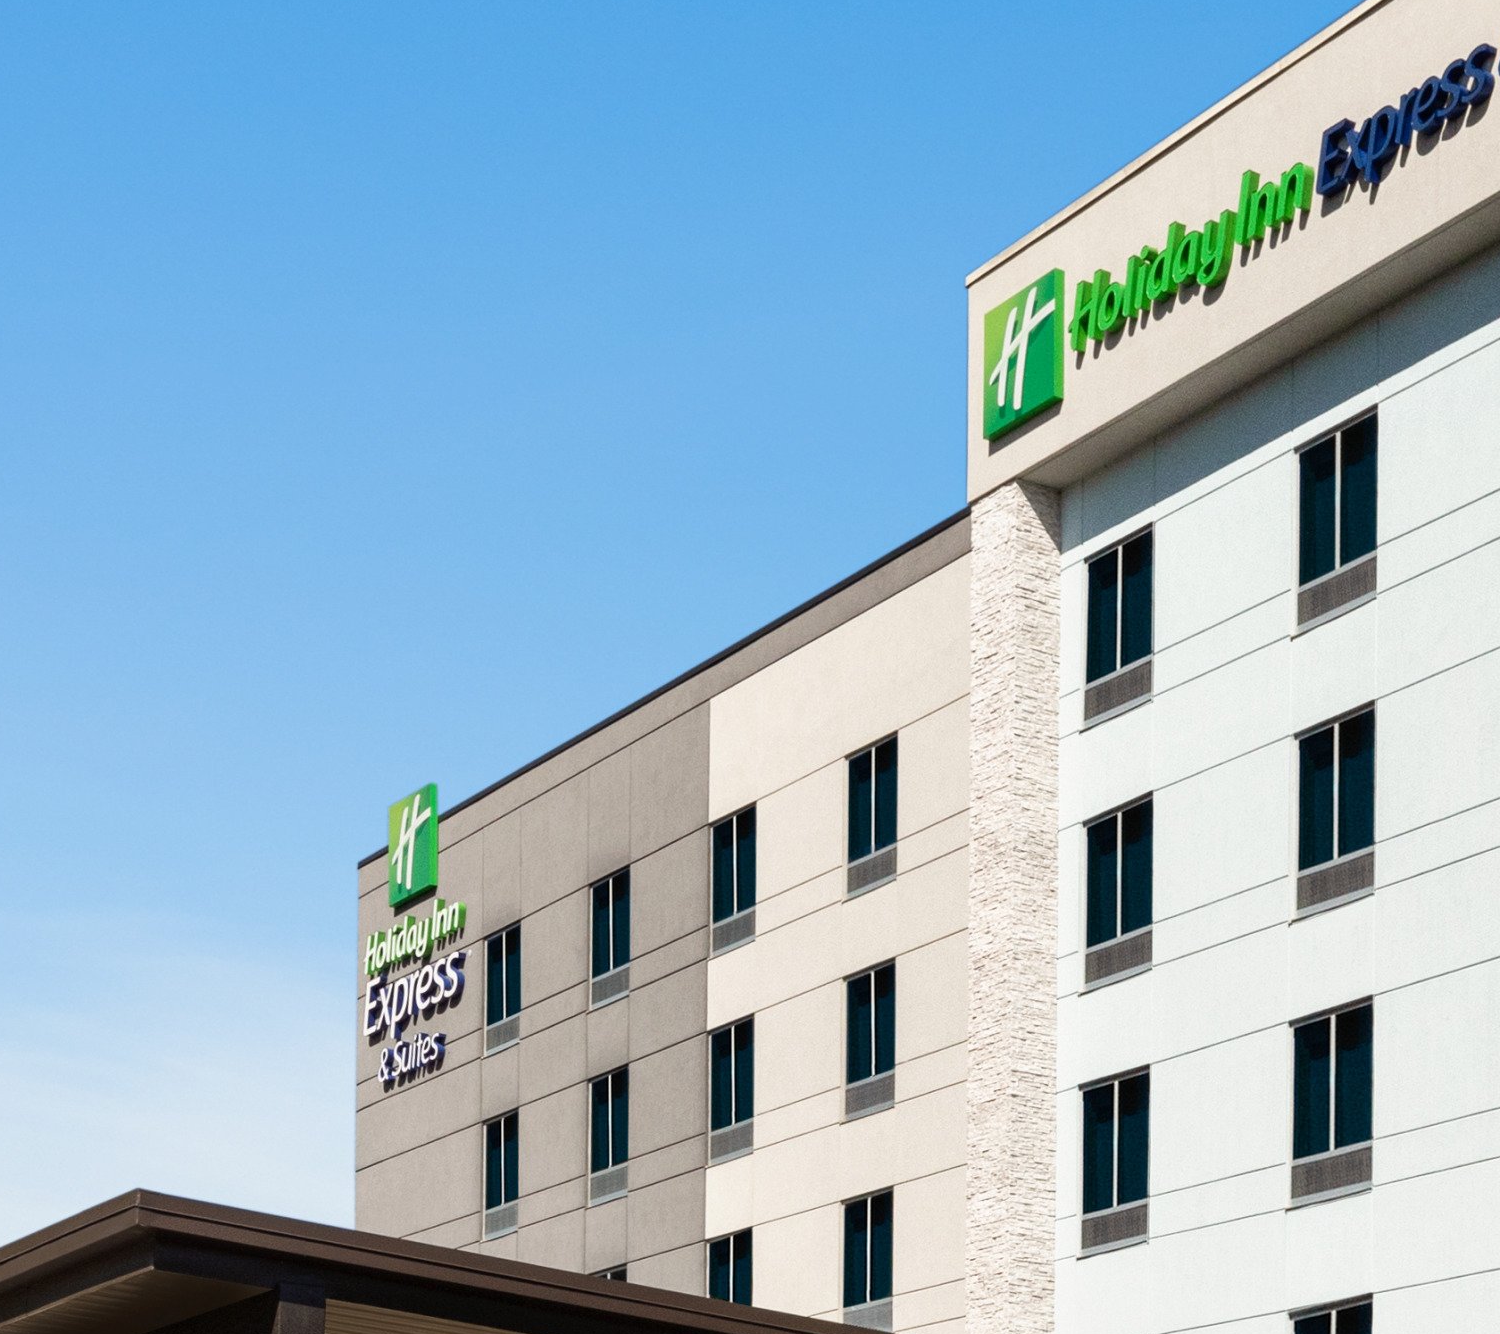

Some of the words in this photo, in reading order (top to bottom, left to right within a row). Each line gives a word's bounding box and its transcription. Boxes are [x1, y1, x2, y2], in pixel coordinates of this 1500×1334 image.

[1068, 209, 1237, 352] Holiday
[1235, 162, 1315, 246] Inn
[1316, 43, 1497, 195] Express
[363, 915, 431, 975] Holiday
[431, 898, 466, 940] Inn
[363, 950, 466, 1039] Express
[378, 1047, 394, 1083] &
[392, 1033, 446, 1077] Suites
